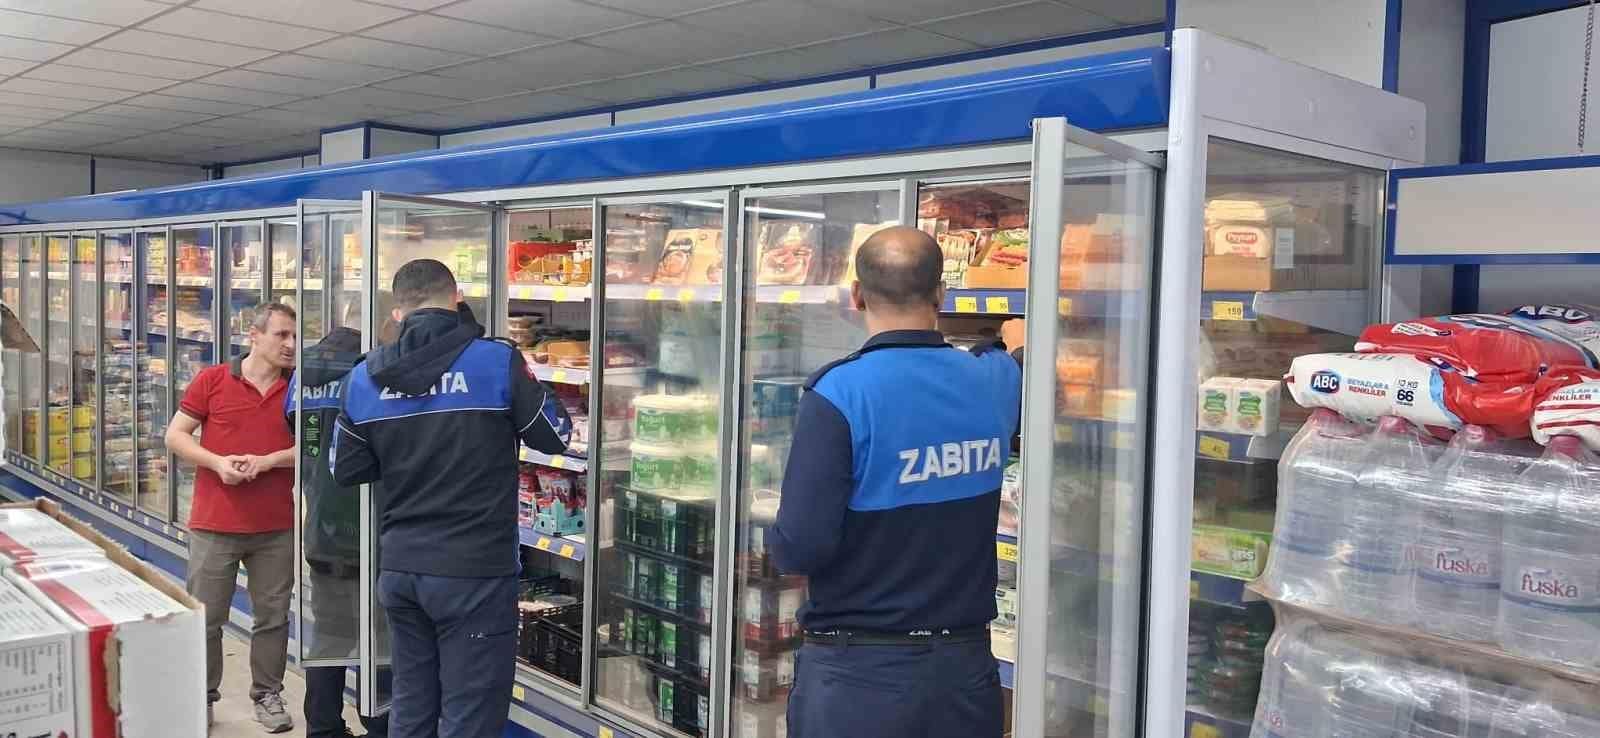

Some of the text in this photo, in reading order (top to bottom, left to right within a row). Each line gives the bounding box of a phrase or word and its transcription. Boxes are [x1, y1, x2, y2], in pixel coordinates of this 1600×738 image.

[1313, 375, 1338, 390] ABC
[1397, 389, 1415, 402] 66
[899, 437, 1001, 484] ZABITA
[1436, 552, 1489, 575] fuska
[1521, 572, 1578, 598] fuska
